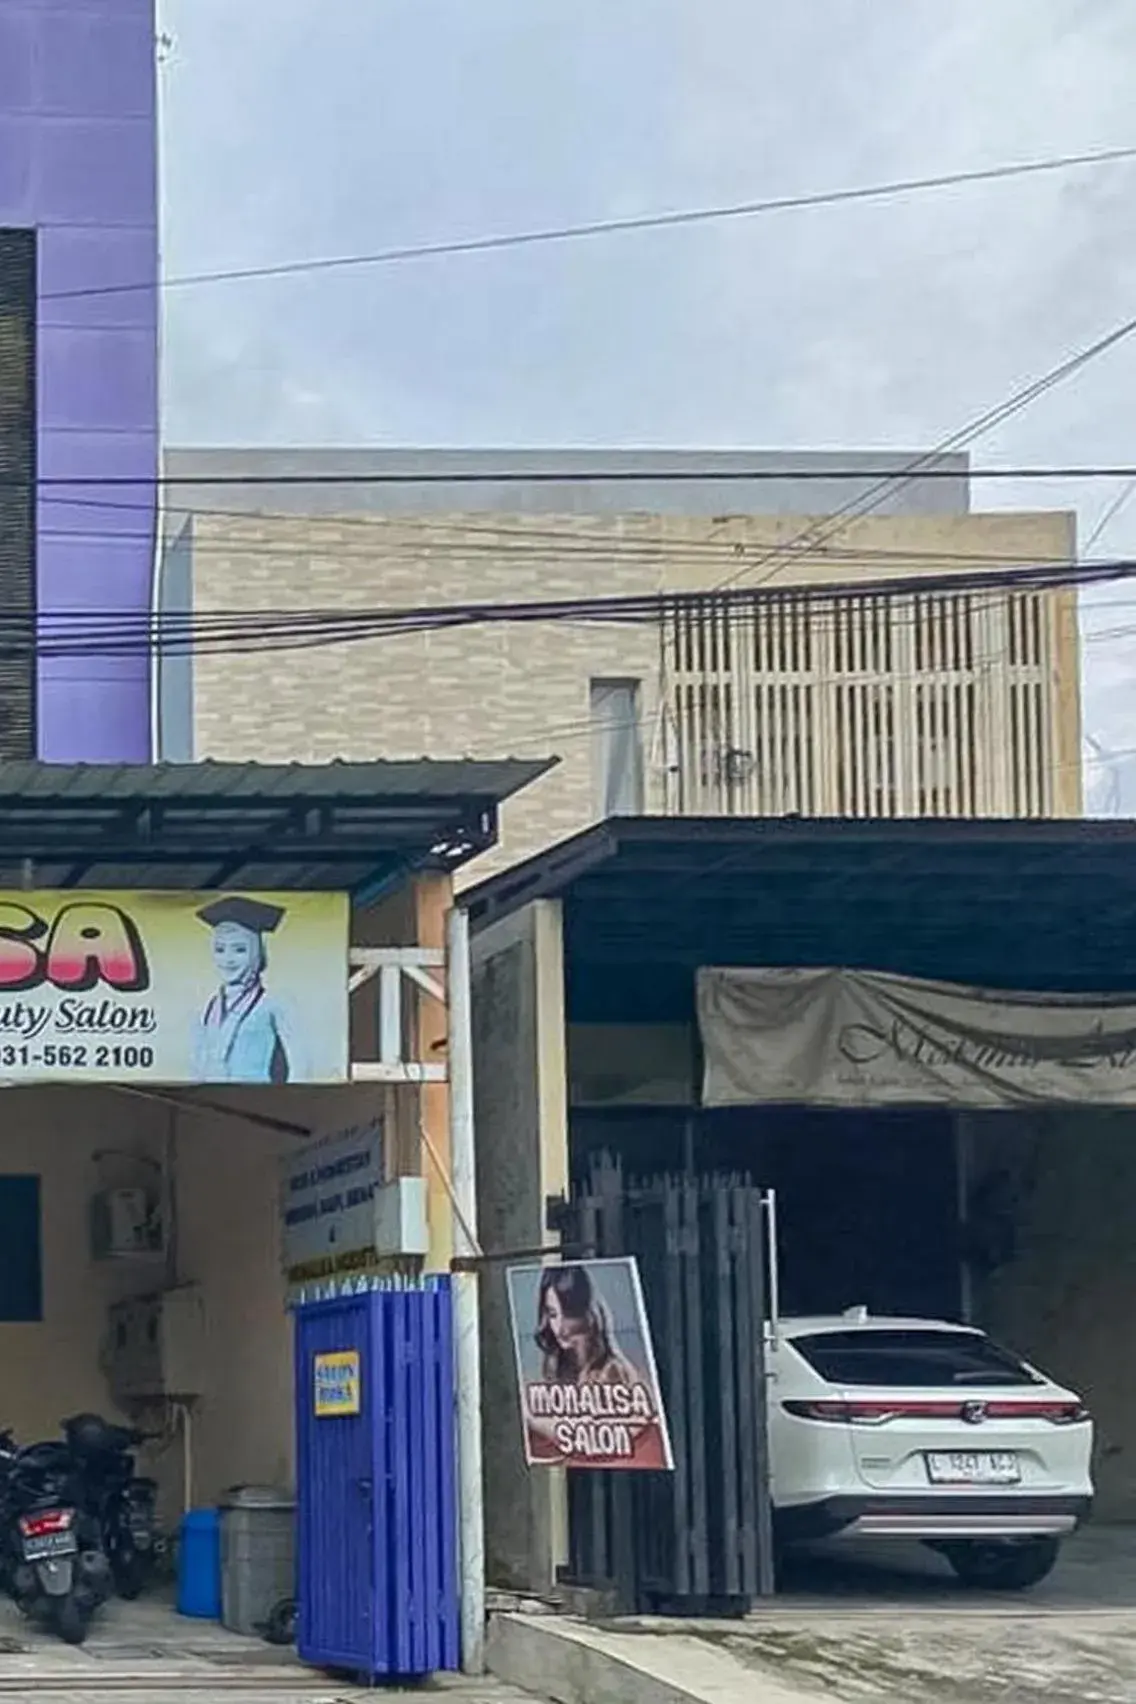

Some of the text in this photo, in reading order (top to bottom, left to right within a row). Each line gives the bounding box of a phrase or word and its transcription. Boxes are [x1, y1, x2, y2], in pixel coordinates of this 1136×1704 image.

[54, 997, 156, 1035] Salon
[94, 1044, 154, 1067] 2100
[528, 1383, 653, 1416] MONALISA
[555, 1423, 633, 1455] SALON
